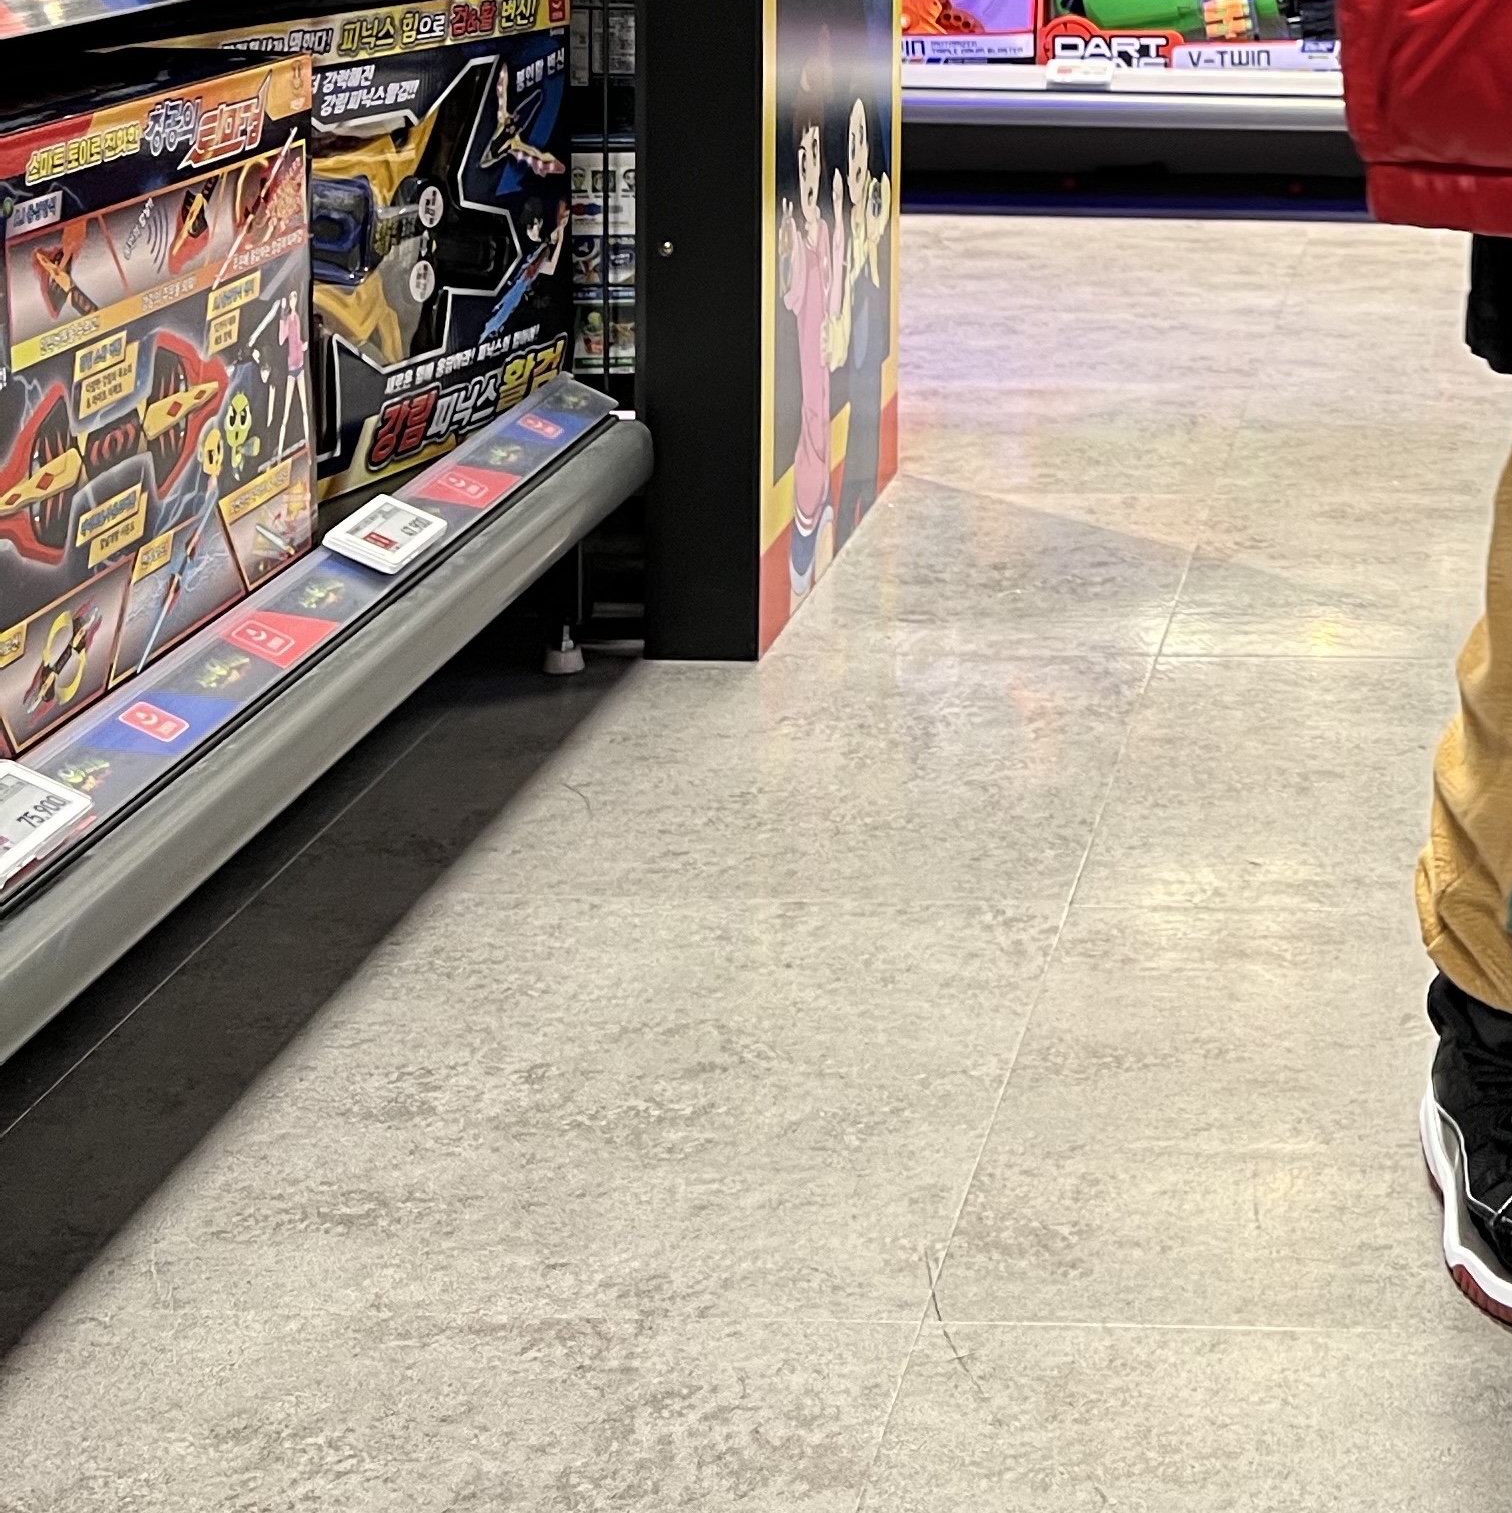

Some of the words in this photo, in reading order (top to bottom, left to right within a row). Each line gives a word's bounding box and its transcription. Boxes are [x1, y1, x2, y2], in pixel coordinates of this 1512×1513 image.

[337, 20, 395, 56] 피닉스
[400, 11, 446, 46] 힘으로
[1054, 37, 1167, 58] DART
[1188, 50, 1271, 68] V-TWIN
[26, 142, 66, 186] 스마트
[66, 132, 102, 173] 토이로
[16, 793, 69, 830] 75,900
